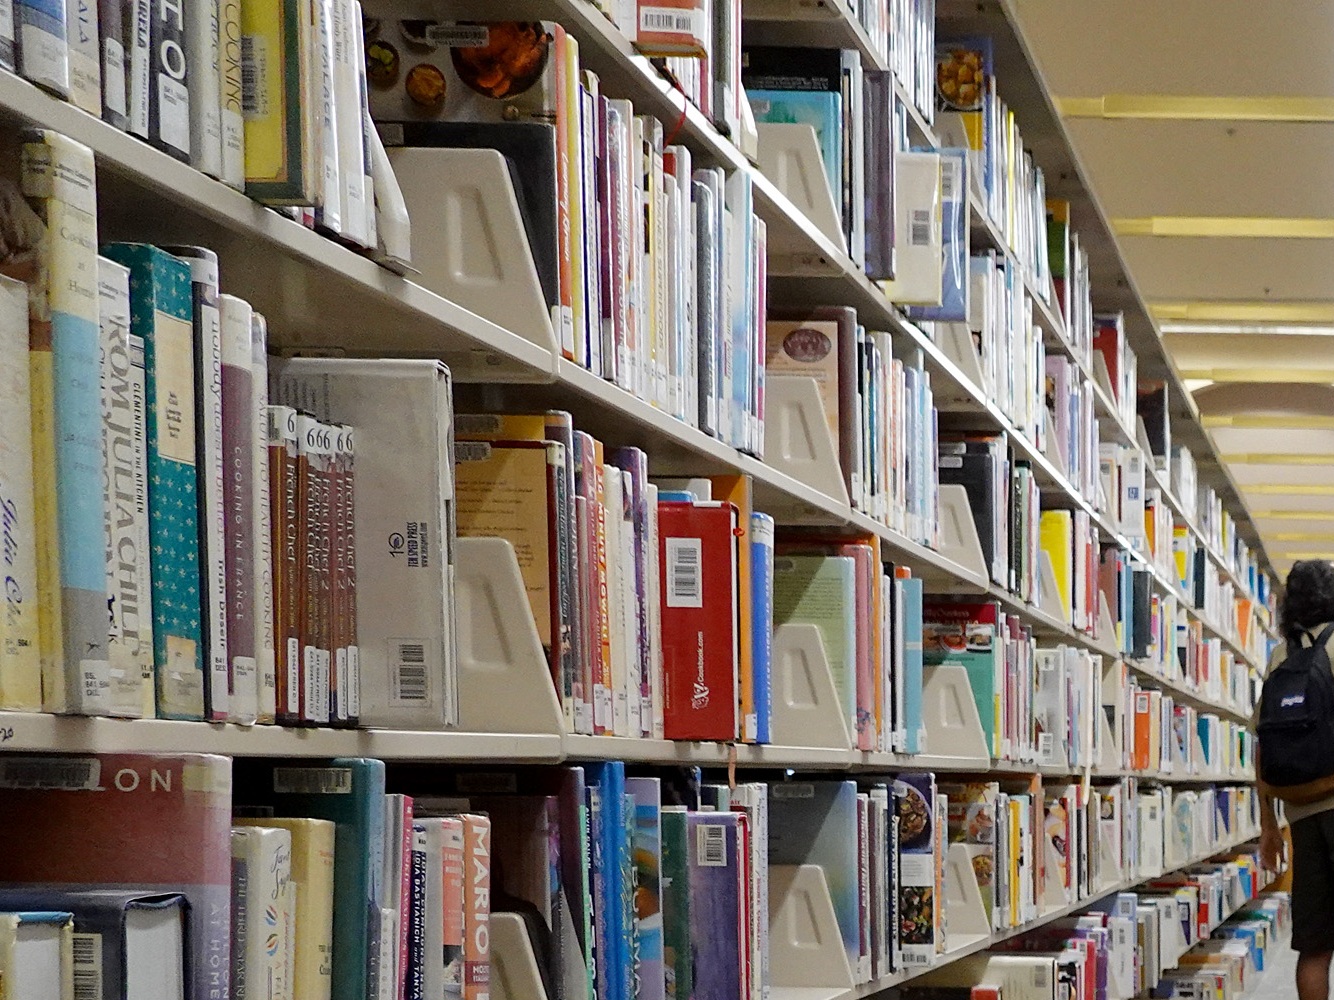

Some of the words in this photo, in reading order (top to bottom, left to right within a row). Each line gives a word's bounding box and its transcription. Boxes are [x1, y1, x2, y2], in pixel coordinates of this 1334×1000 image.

[136, 472, 145, 515] KITCHEN
[234, 446, 243, 522] COOKING
[286, 463, 297, 520] French
[305, 471, 317, 528] French
[235, 533, 243, 551] IN
[286, 523, 297, 564] Chef
[306, 531, 317, 570] Chef
[407, 521, 418, 539] PRESS
[235, 558, 245, 621] FRANCE
[210, 902, 220, 926] AT
[413, 878, 422, 944] BASTIANICH
[472, 826, 489, 956] MARIO
[210, 938, 221, 1000] HOME
[412, 966, 421, 999] TANYA
